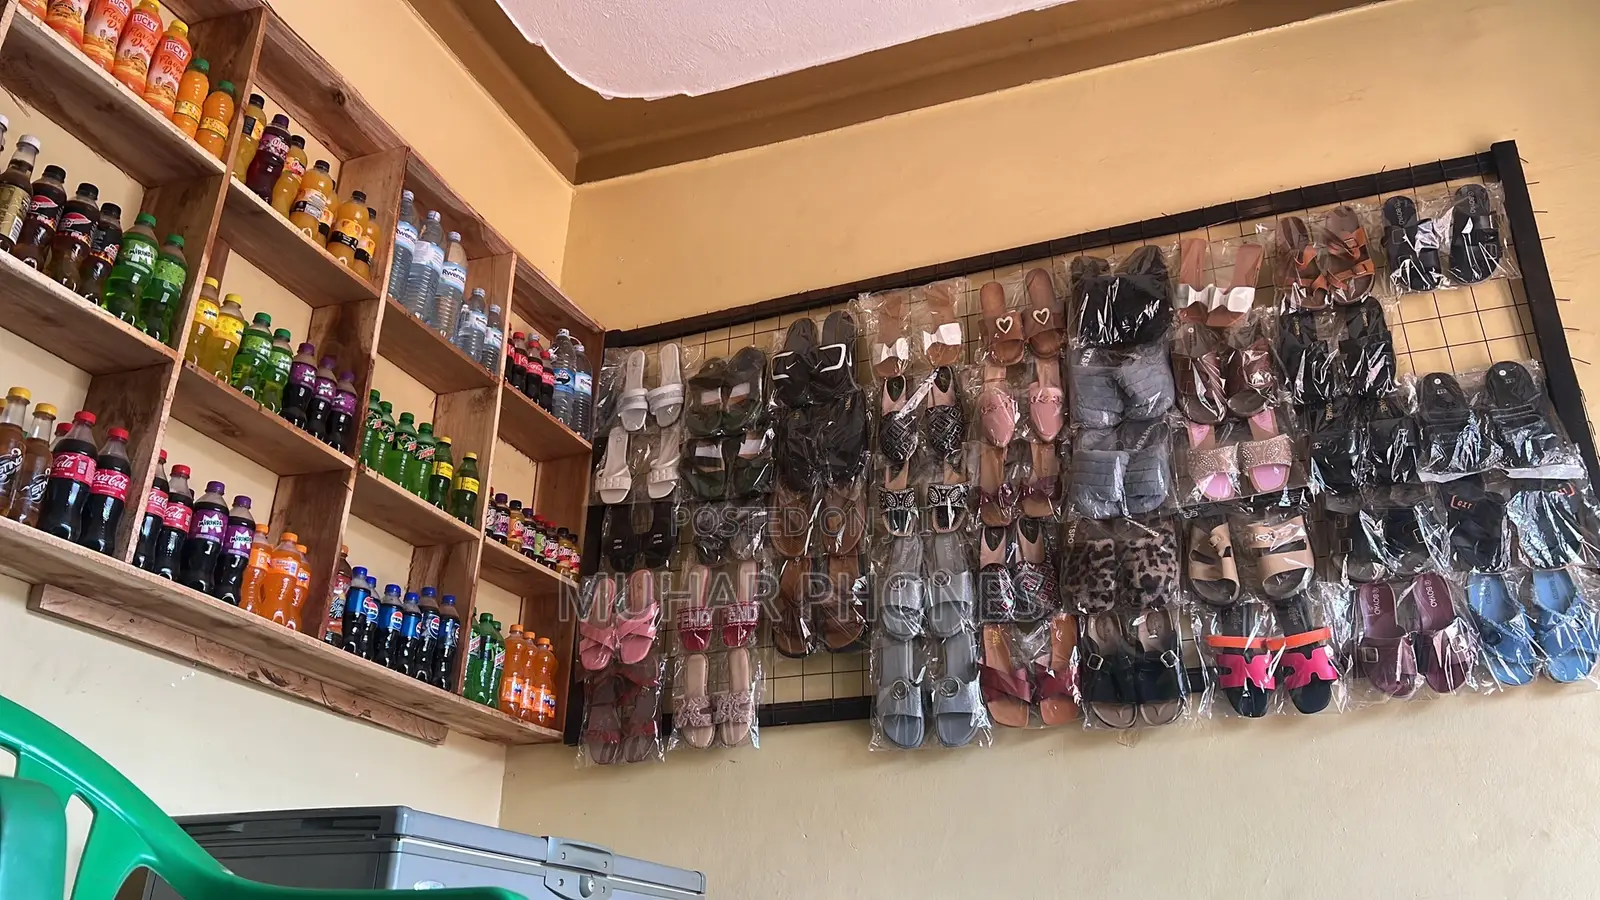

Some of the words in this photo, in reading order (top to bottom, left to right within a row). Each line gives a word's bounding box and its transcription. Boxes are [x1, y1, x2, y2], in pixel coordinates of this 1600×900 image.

[133, 13, 156, 30] LUCKY
[165, 42, 187, 59] LUCKY
[1372, 593, 1381, 615] BOYAO
[1425, 586, 1438, 607] BOYAO
